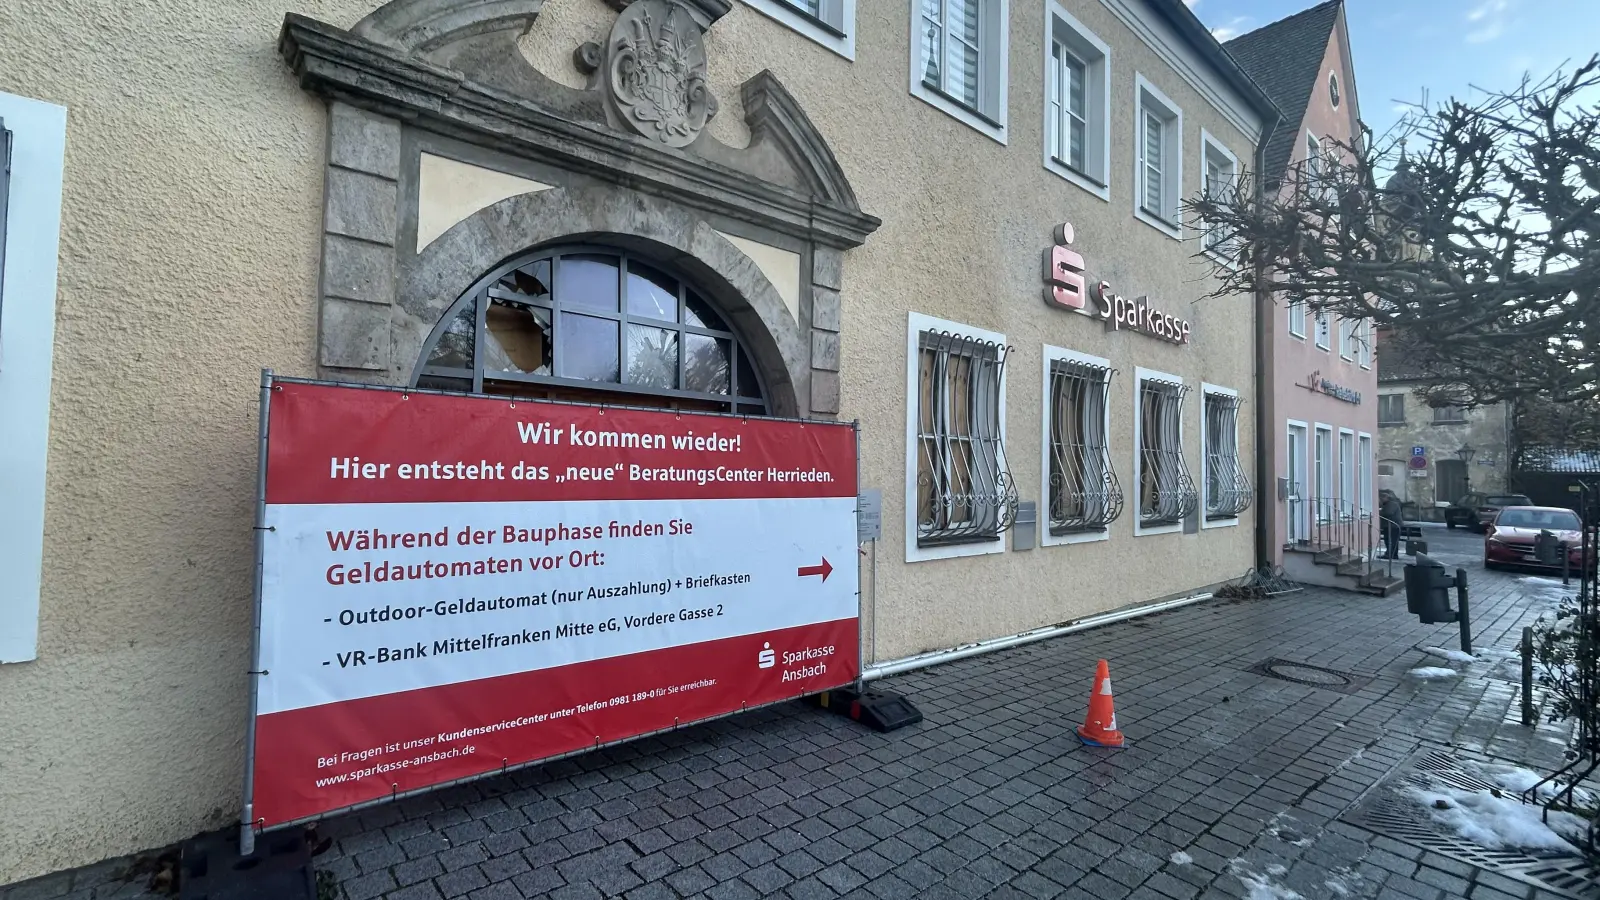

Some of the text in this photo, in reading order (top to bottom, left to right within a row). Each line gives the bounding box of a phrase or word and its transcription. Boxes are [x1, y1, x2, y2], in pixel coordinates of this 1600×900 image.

[1098, 280, 1190, 344] Sparkasse
[517, 421, 741, 452] Wir kommen wieder!
[330, 457, 834, 485] Hier entsteht das „neue“ BeratungsCenter Herrieden.
[326, 519, 693, 551] Während der Bauphase finden Sie
[326, 550, 605, 585] Geldautomaten vor Ort:
[339, 592, 548, 626] Outdoor-Geldautomat
[551, 587, 583, 606] (nur
[586, 578, 672, 600] Auszahlung)
[675, 579, 683, 589] +
[685, 572, 751, 589] Briefkasten
[336, 642, 427, 668] VR-Bank
[433, 629, 551, 656] Mittelfranken
[555, 622, 594, 639] Mitte
[598, 617, 621, 632] eG,
[624, 610, 675, 629] Vordere
[679, 607, 714, 621] Gasse
[716, 604, 724, 616] 2
[782, 644, 835, 665] Sparkasse
[782, 662, 826, 682] Ansbach
[317, 678, 717, 768] Bei Fragen ist unser KundenserviceCenter unter Telefon 0981 189-0 für Sie erreichbar.
[316, 744, 475, 788] www.sparkasse-ansbach.de
